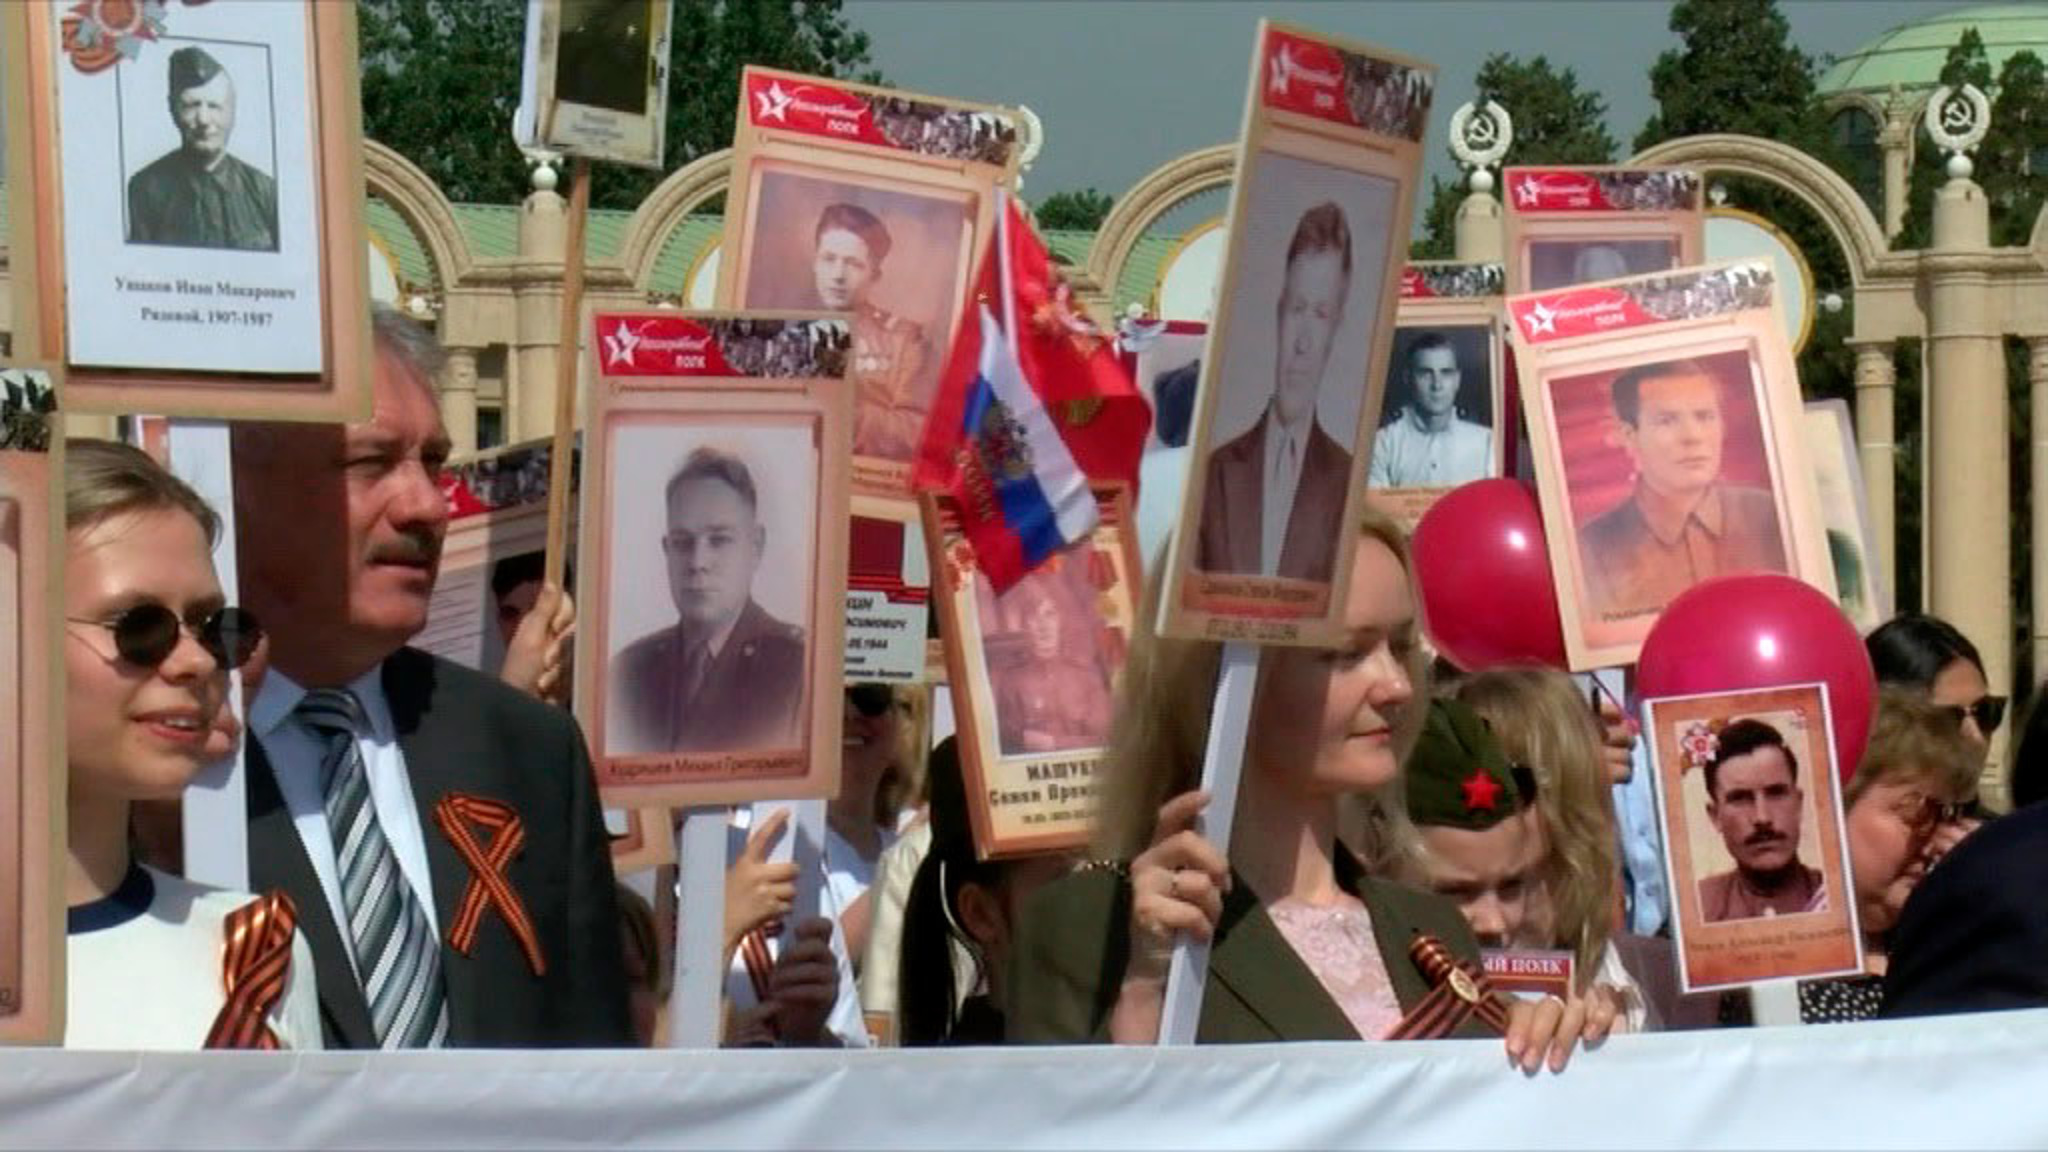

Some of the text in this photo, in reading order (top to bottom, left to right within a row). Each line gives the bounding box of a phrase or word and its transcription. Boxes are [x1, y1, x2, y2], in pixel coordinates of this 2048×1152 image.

[175, 280, 214, 296] Иван
[216, 281, 297, 301] Макарович
[1511, 958, 1562, 975] ПОЛК
